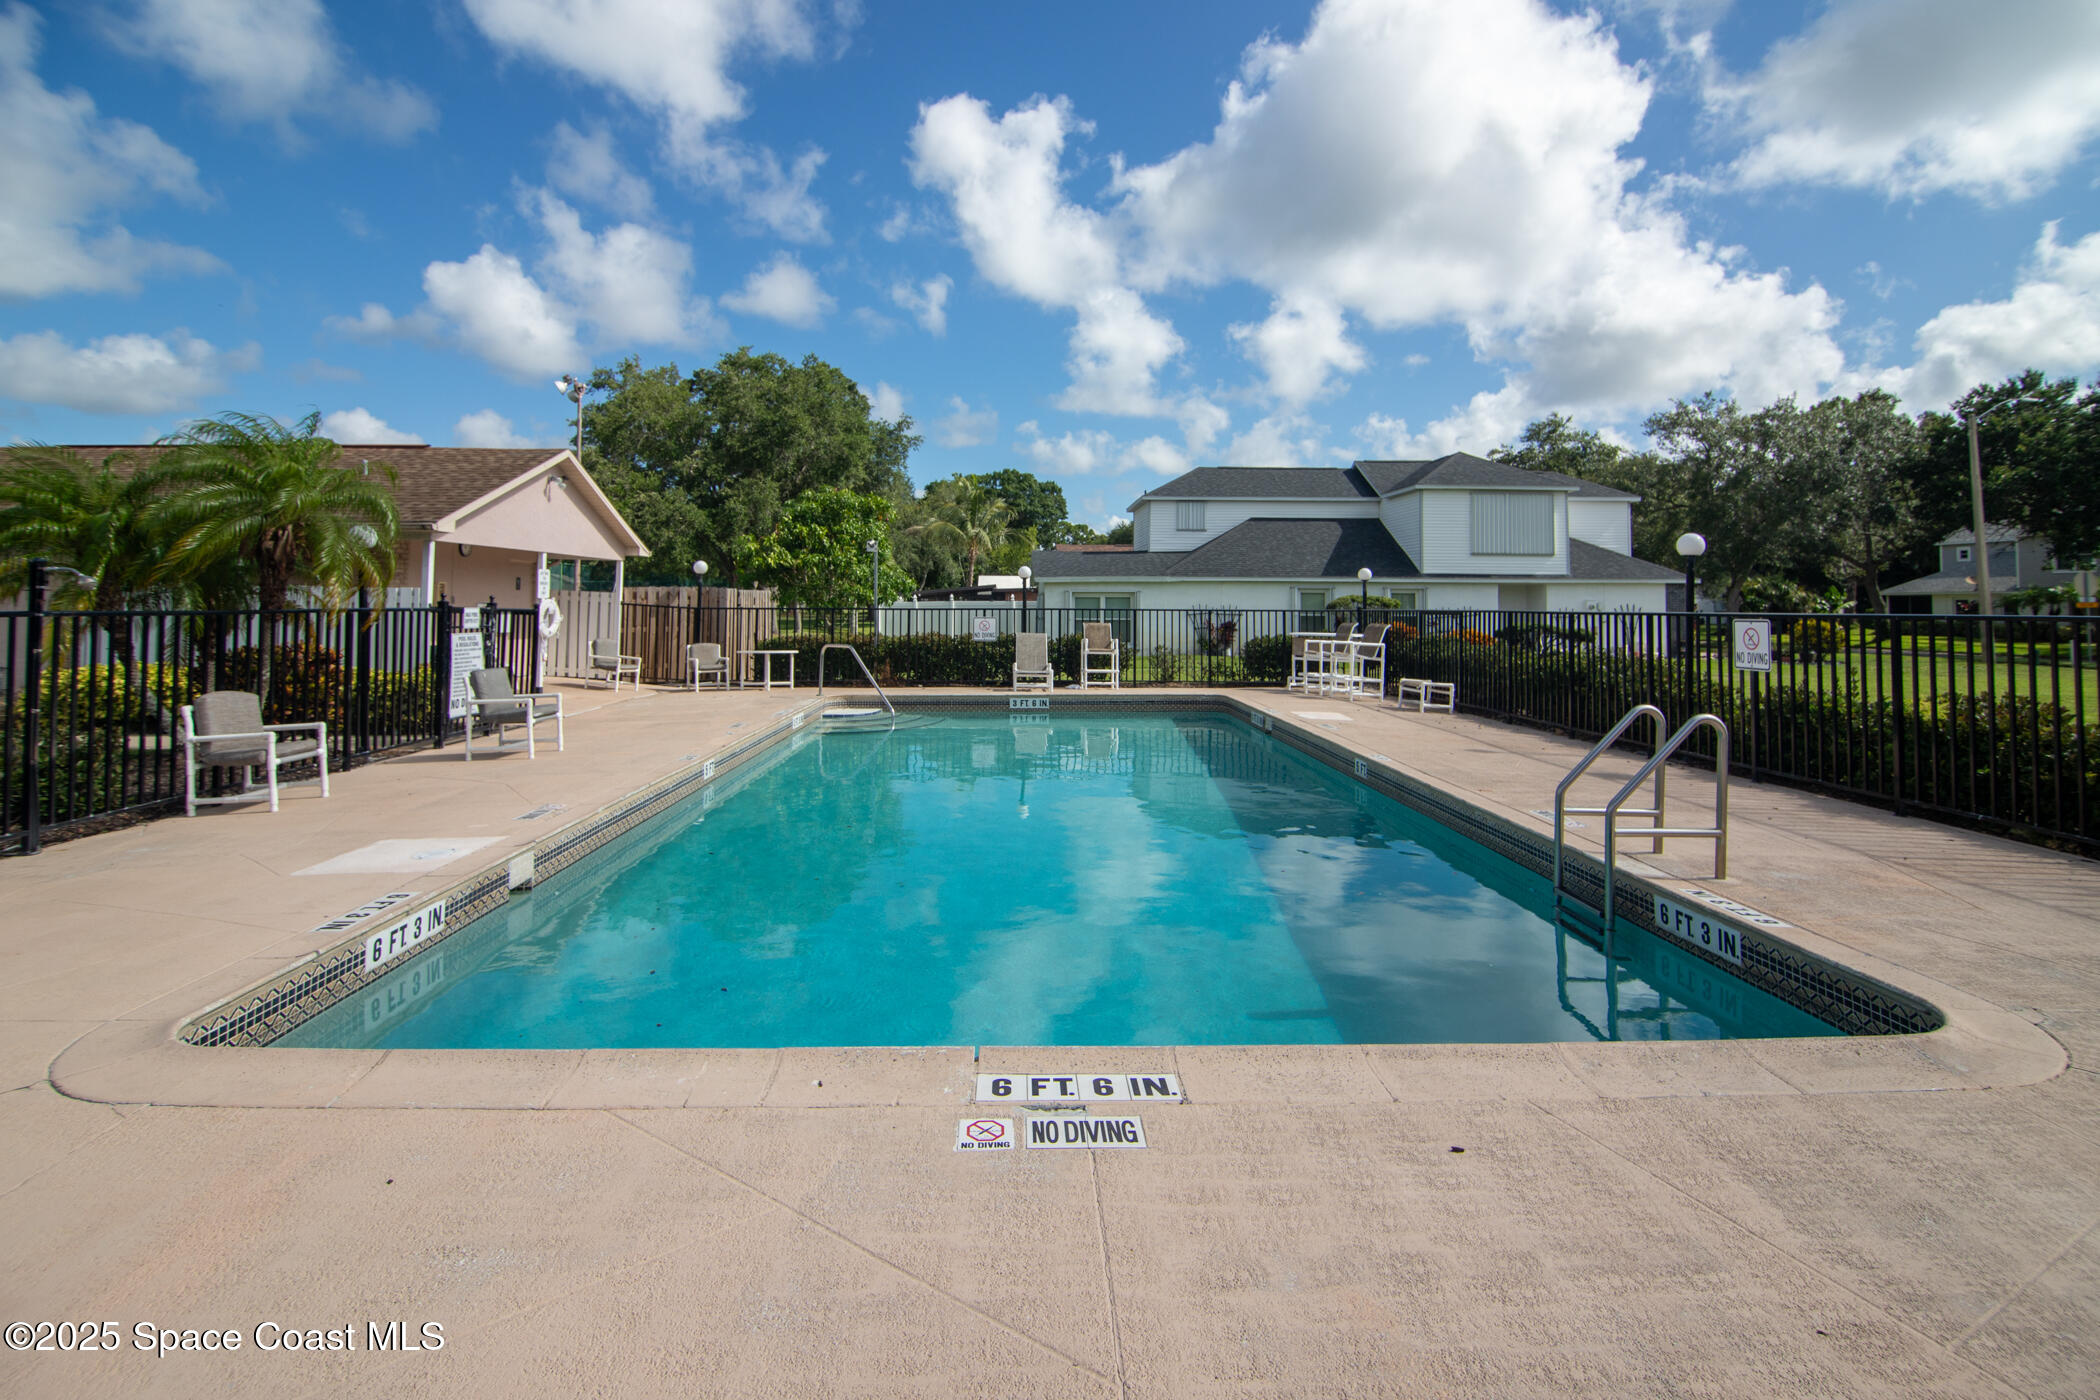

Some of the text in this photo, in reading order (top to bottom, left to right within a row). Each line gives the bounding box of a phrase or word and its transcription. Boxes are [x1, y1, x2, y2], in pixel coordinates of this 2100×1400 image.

[1736, 652, 1768, 665] NO DIVING
[451, 699, 460, 709] NO
[1012, 699, 1018, 707] 3
[1032, 699, 1037, 707] 6
[373, 938, 382, 962] 6
[414, 916, 422, 939] 3
[1660, 903, 1669, 925] 6
[1701, 922, 1711, 945] 3
[1718, 928, 1740, 959] IN.
[991, 1077, 1178, 1097] 6 FT. 6 IN.
[1032, 1120, 1139, 1144] NO DIVING
[977, 1141, 1010, 1149] DIVING
